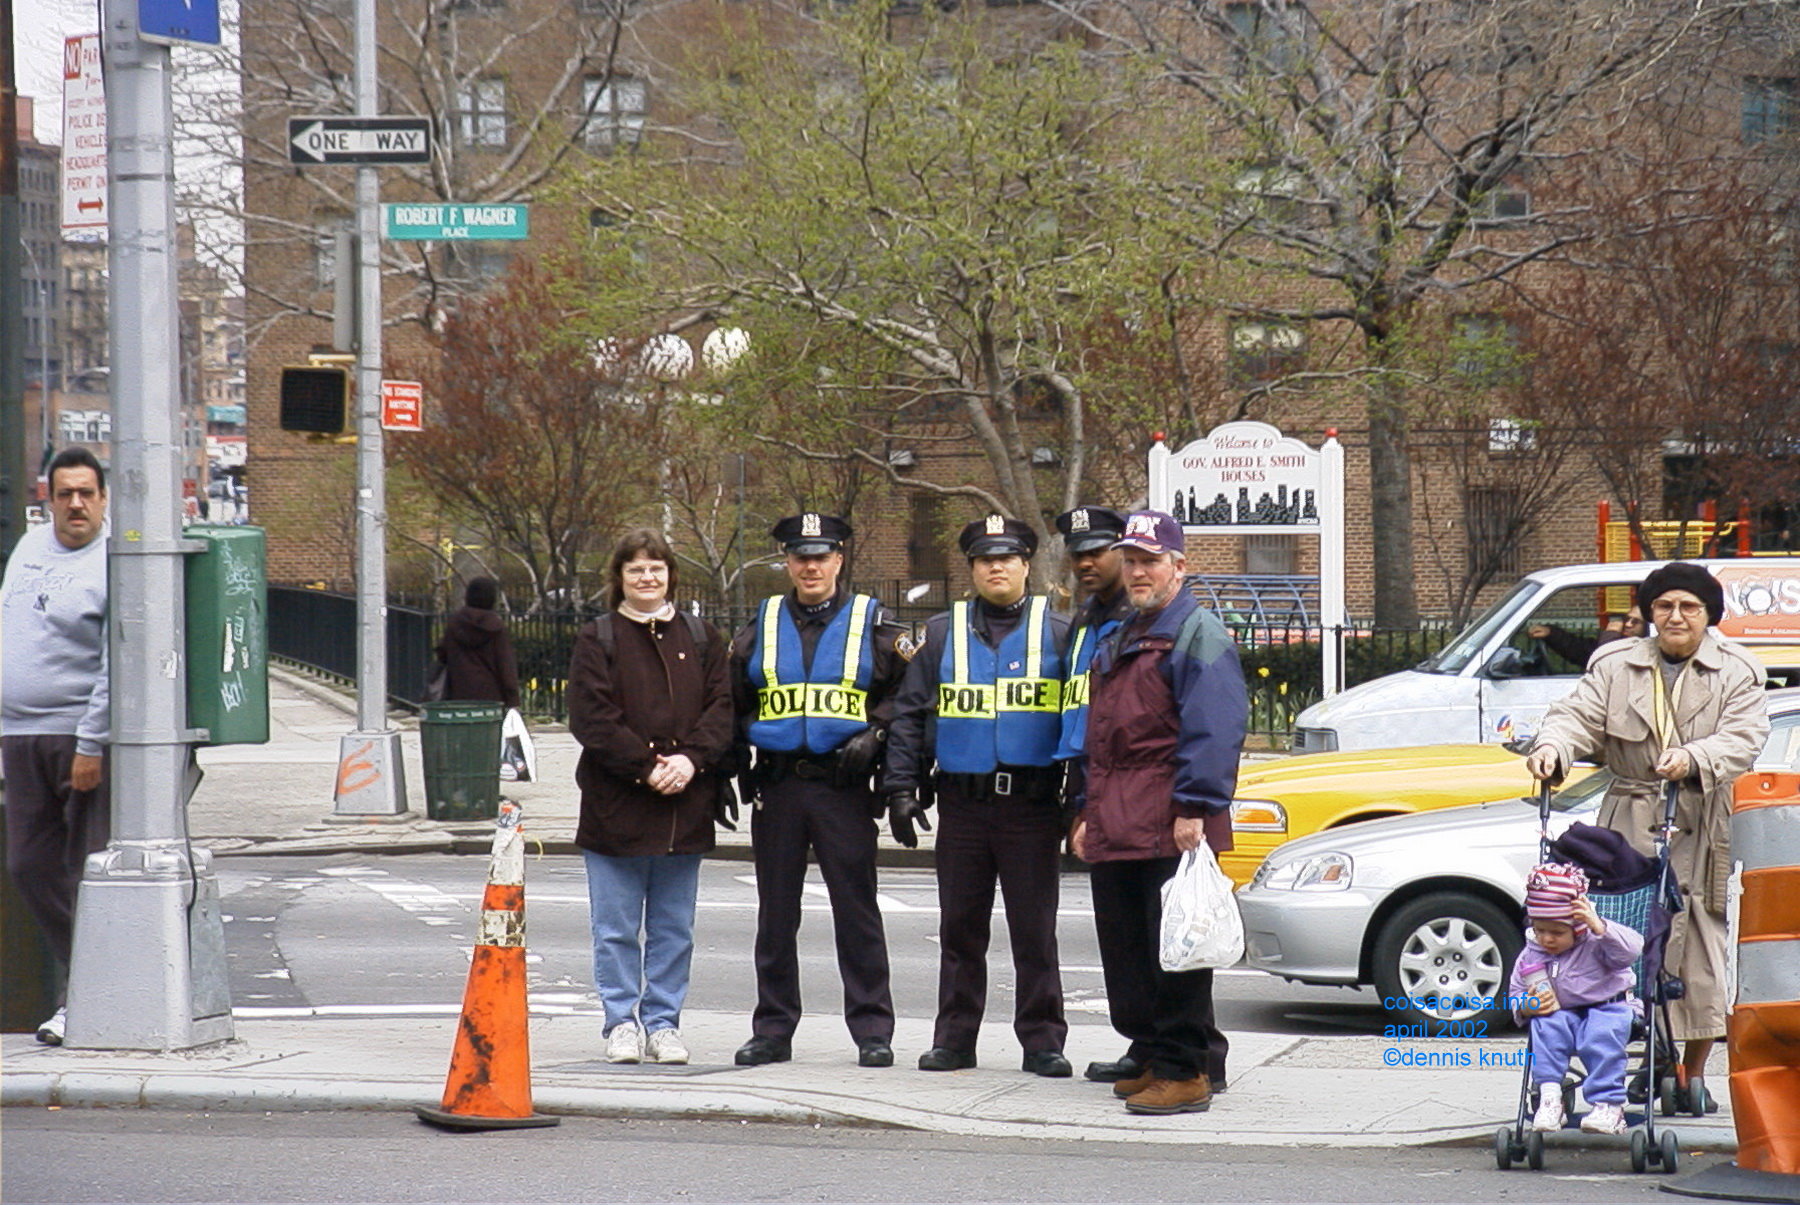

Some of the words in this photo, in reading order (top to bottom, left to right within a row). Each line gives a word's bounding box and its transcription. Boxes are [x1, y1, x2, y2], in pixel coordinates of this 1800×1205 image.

[66, 41, 80, 75] NO
[82, 47, 98, 64] PAR
[68, 114, 93, 129] POLICE
[96, 112, 106, 127] DE
[309, 132, 350, 151] ONE
[376, 131, 419, 150] WAY
[395, 206, 443, 226] ROBERT
[449, 206, 458, 226] F
[463, 206, 516, 226] WAGNER
[441, 227, 469, 238] PLACE
[1211, 456, 1253, 468] ALFRED
[1270, 455, 1305, 468] SMITH
[1221, 470, 1266, 482] HOUSES
[761, 688, 861, 716] POLICE
[941, 681, 1048, 714] POLICE
